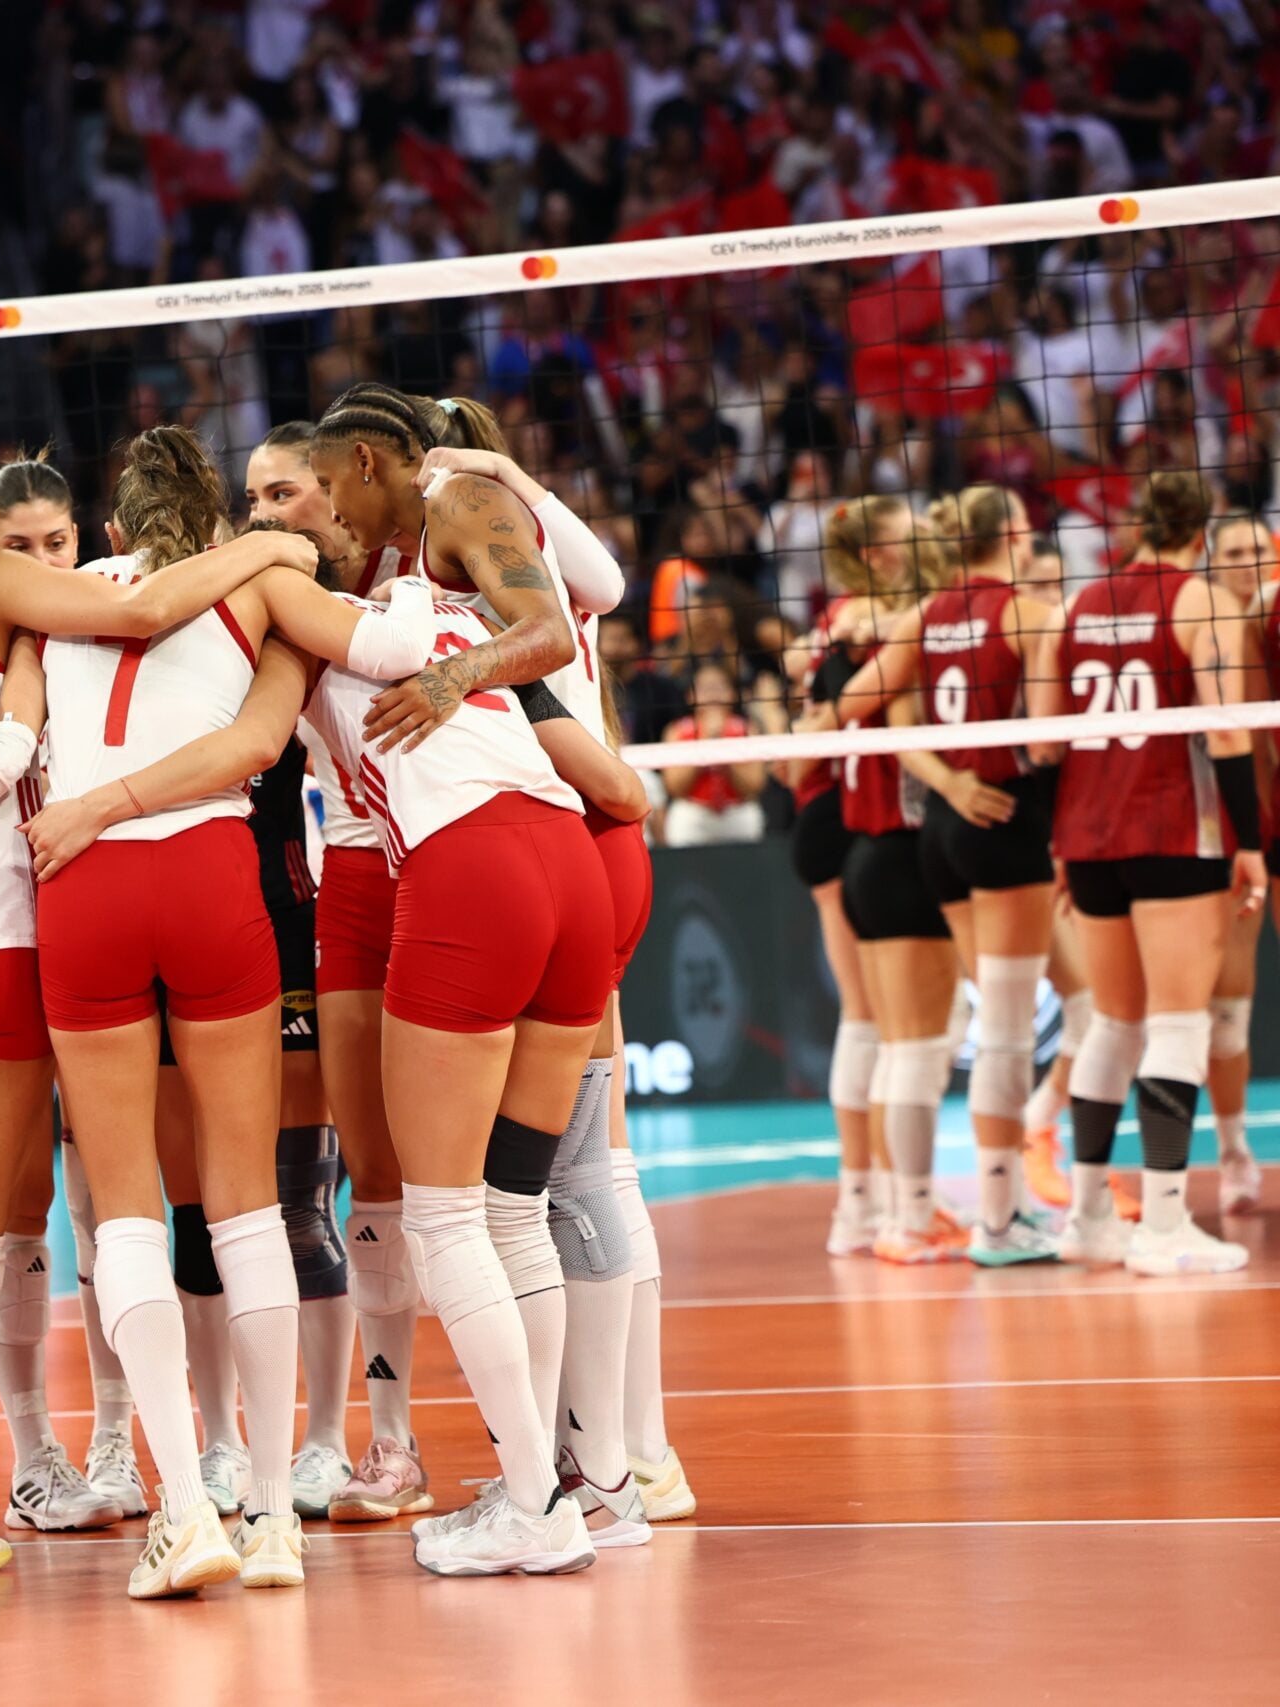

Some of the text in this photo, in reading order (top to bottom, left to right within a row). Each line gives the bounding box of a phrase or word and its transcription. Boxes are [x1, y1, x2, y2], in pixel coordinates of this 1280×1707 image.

[710, 224, 943, 256] CEV Trendyol EuroVolley 2026 Women
[94, 635, 152, 747] 7
[934, 666, 969, 726] 9
[1070, 657, 1159, 751] 20
